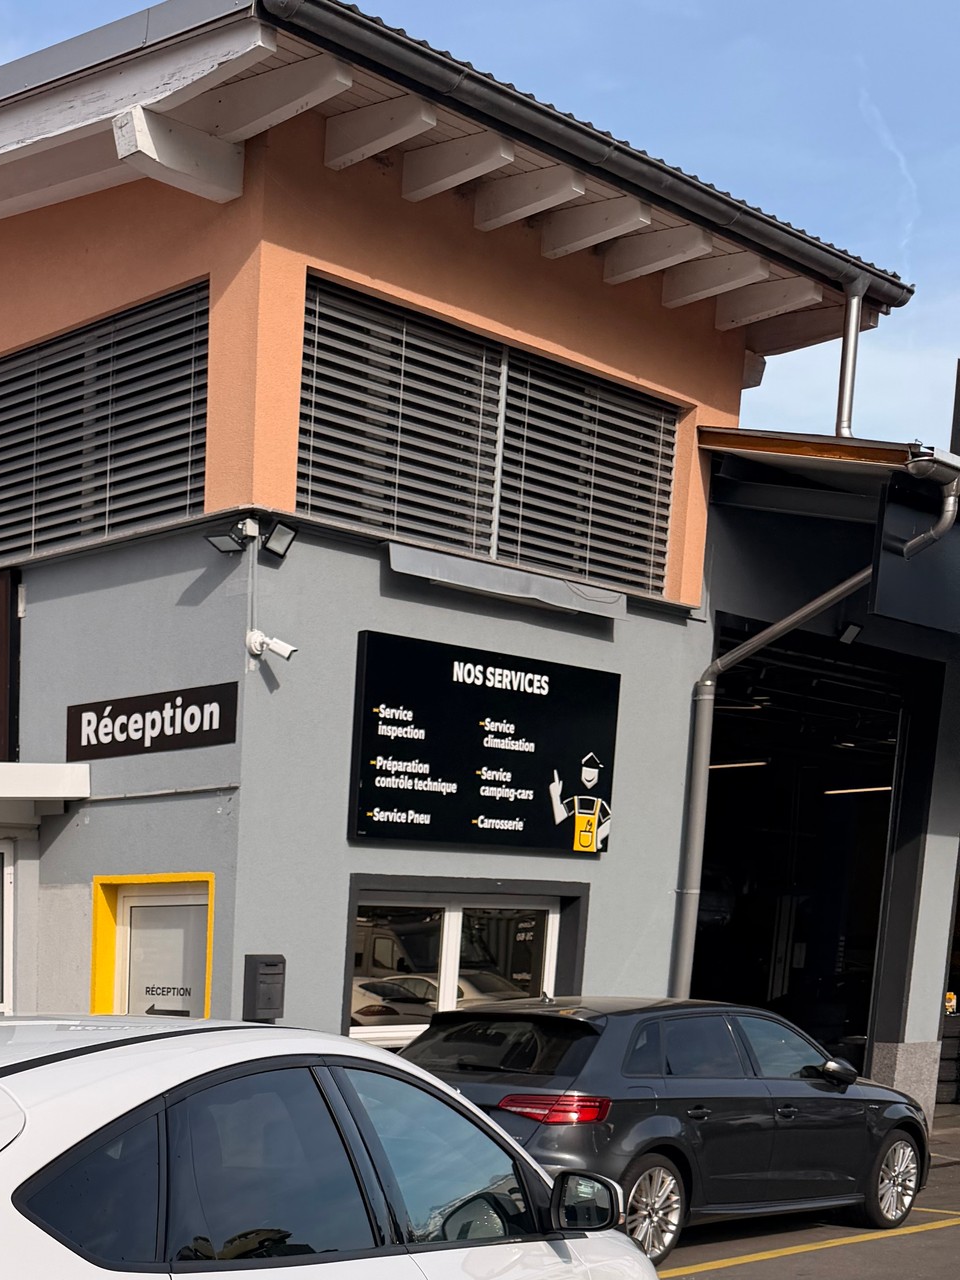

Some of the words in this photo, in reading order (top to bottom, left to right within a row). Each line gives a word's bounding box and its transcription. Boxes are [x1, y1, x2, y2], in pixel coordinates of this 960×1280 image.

[453, 661, 484, 686] NOS
[485, 666, 549, 696] SERVICES
[80, 696, 220, 747] Réception
[378, 721, 425, 740] inspection
[483, 735, 535, 752] climatisation
[375, 775, 413, 790] contrôle
[414, 777, 458, 795] technique
[480, 785, 534, 801] camping-cars
[407, 810, 431, 825] Pneu
[145, 984, 192, 997] RÉCEPTION
